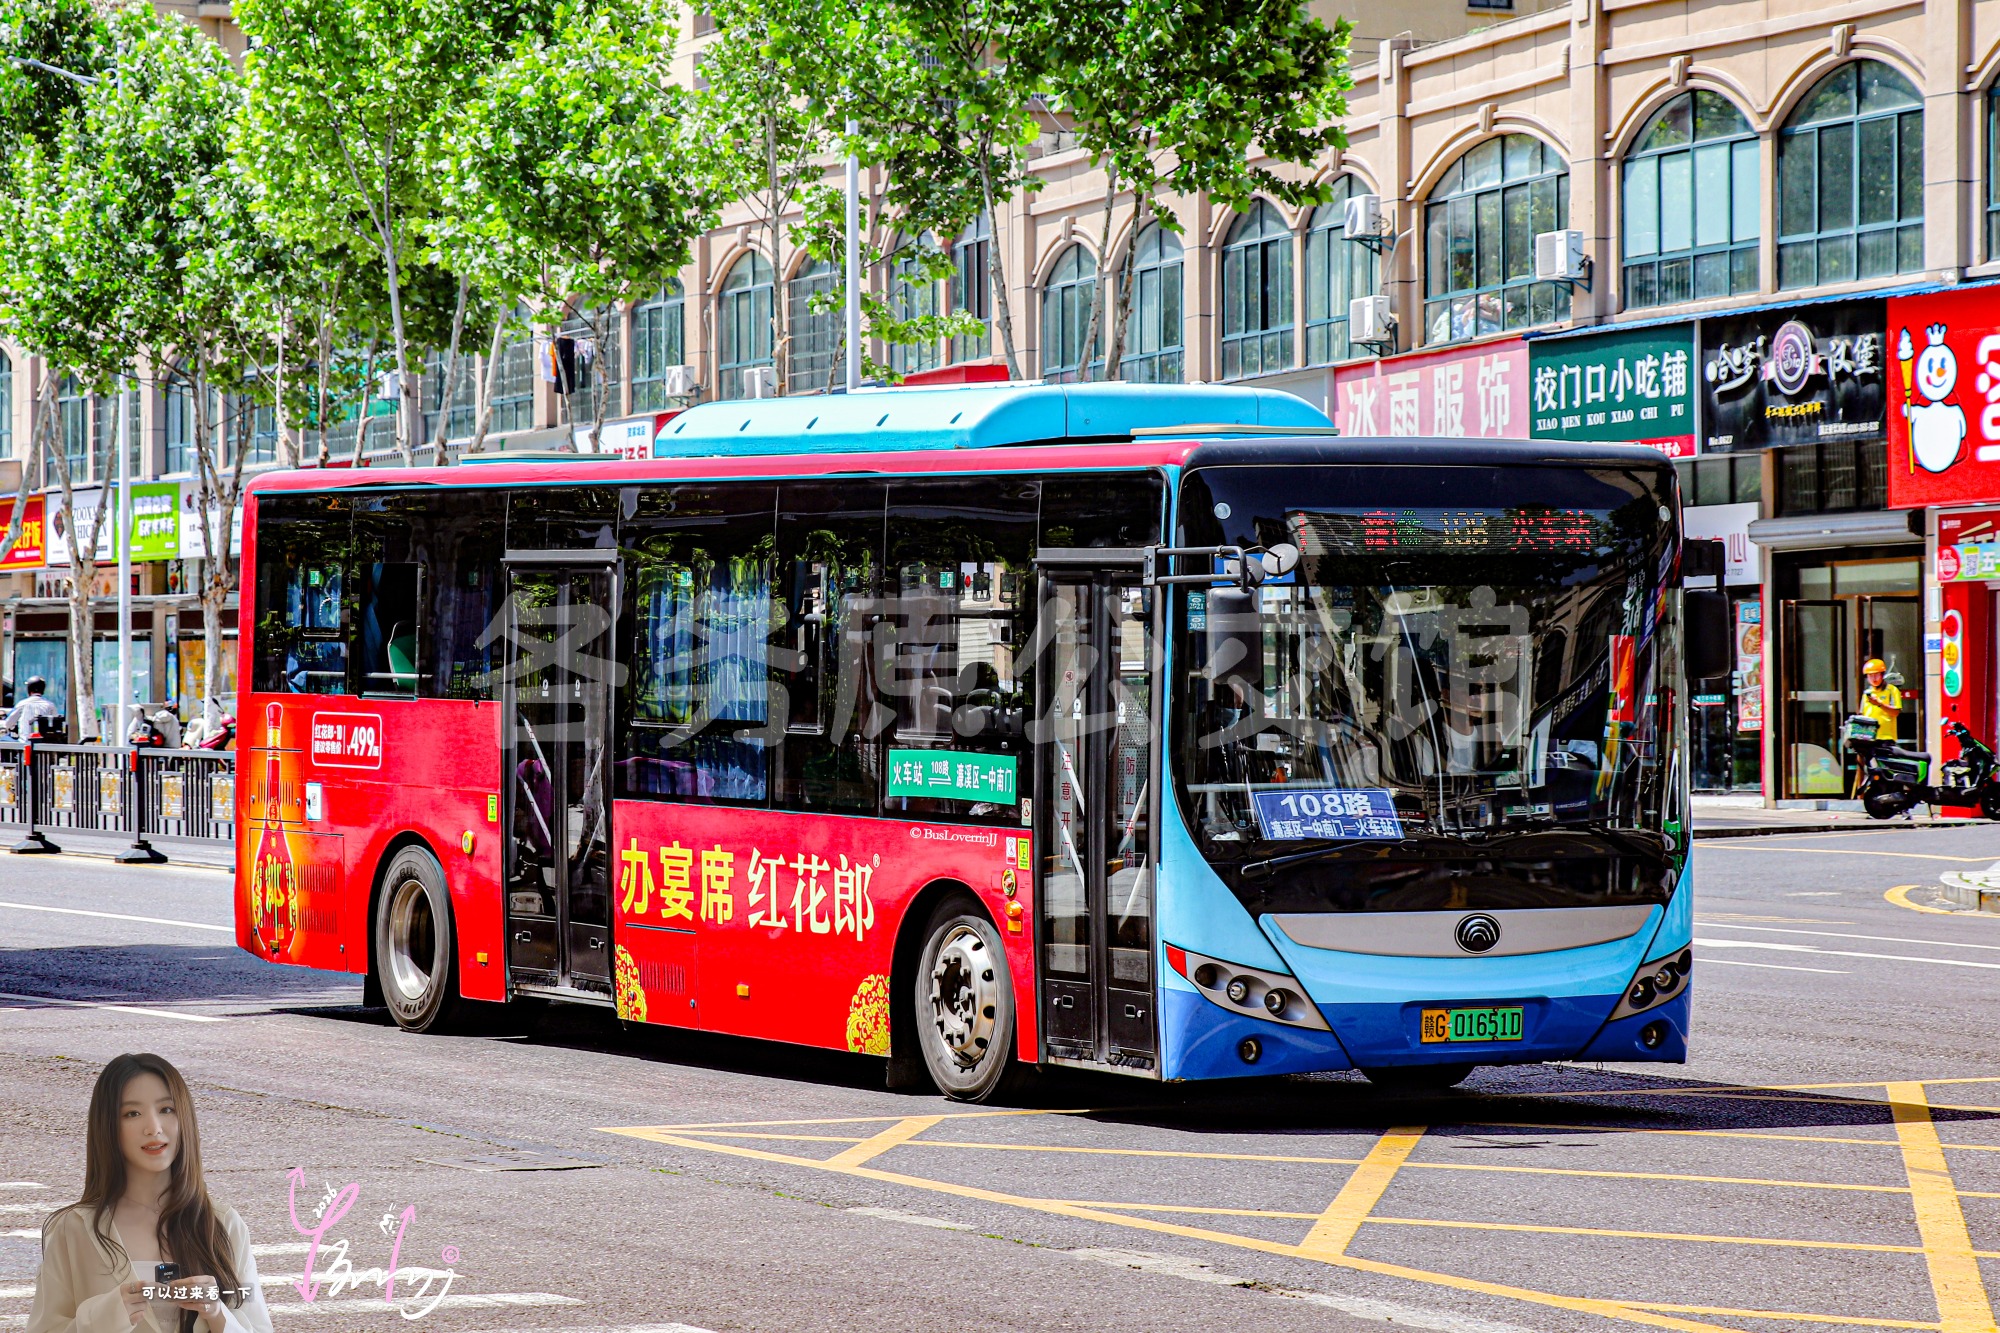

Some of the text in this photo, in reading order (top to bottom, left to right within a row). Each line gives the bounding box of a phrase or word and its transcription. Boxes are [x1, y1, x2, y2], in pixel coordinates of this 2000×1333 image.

[1534, 350, 1688, 412] 校门口小吃铺
[1827, 333, 1881, 381] 汉堡
[1346, 354, 1510, 437] 冰雨服饰
[1536, 403, 1684, 431] XIAO MEN KOU XIAO CHI PU
[1189, 622, 1205, 630] 2022
[893, 760, 1012, 793] 火车站 108路 濂溪区一中南门
[1060, 751, 1072, 861] 注意开门
[1123, 756, 1135, 868] 防止夹伤
[1280, 793, 1374, 817] 108路
[621, 838, 875, 942] 办宴席 红花郎
[1454, 1011, 1521, 1037] 01651D
